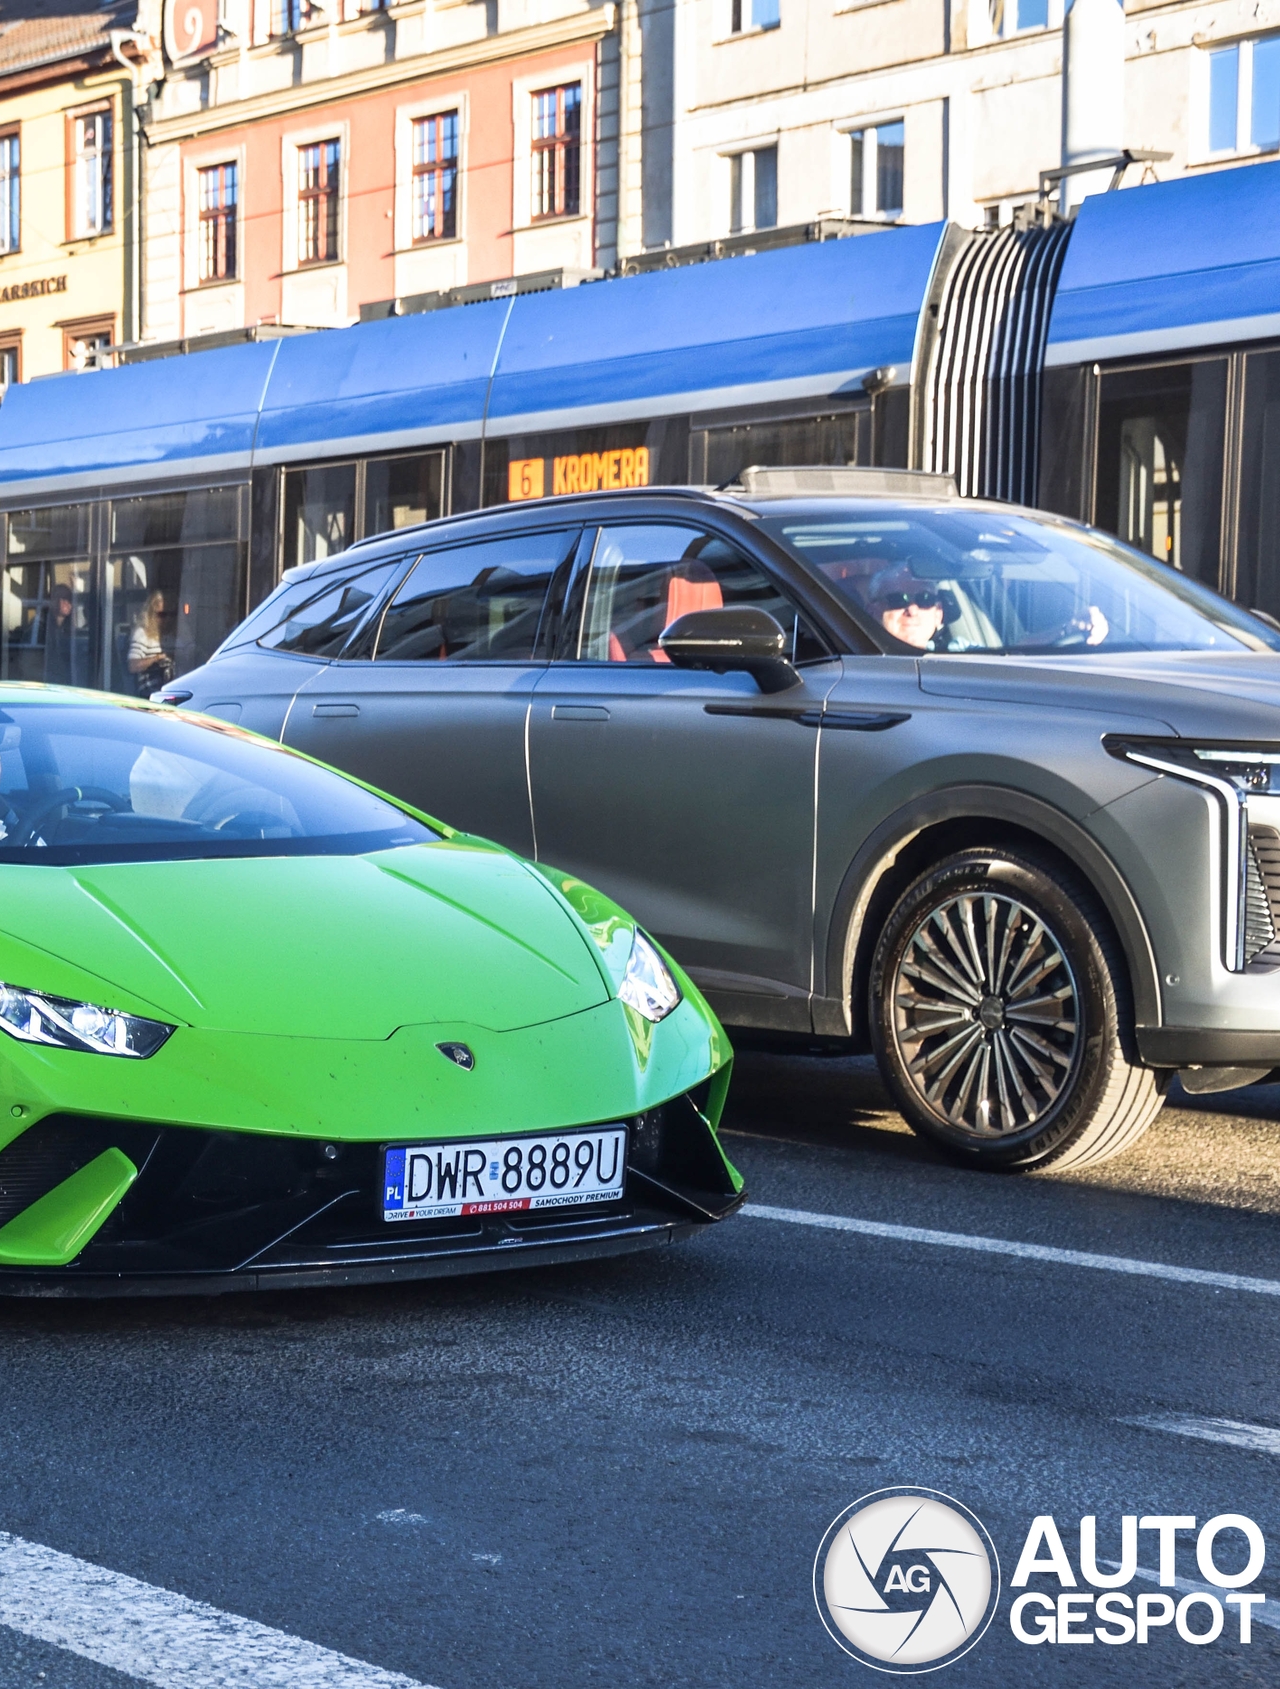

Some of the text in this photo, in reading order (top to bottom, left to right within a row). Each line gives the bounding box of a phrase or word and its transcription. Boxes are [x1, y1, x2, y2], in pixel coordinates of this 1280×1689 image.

[553, 446, 649, 495] KROMERA
[407, 1137, 620, 1203] DWR 8889U
[386, 1187, 401, 1200] PL
[534, 1191, 620, 1207] SAMOCHODY PREMIUM
[477, 1200, 523, 1212] 881 504 504
[387, 1211, 409, 1220] DRIVE
[415, 1209, 433, 1218] YOUR
